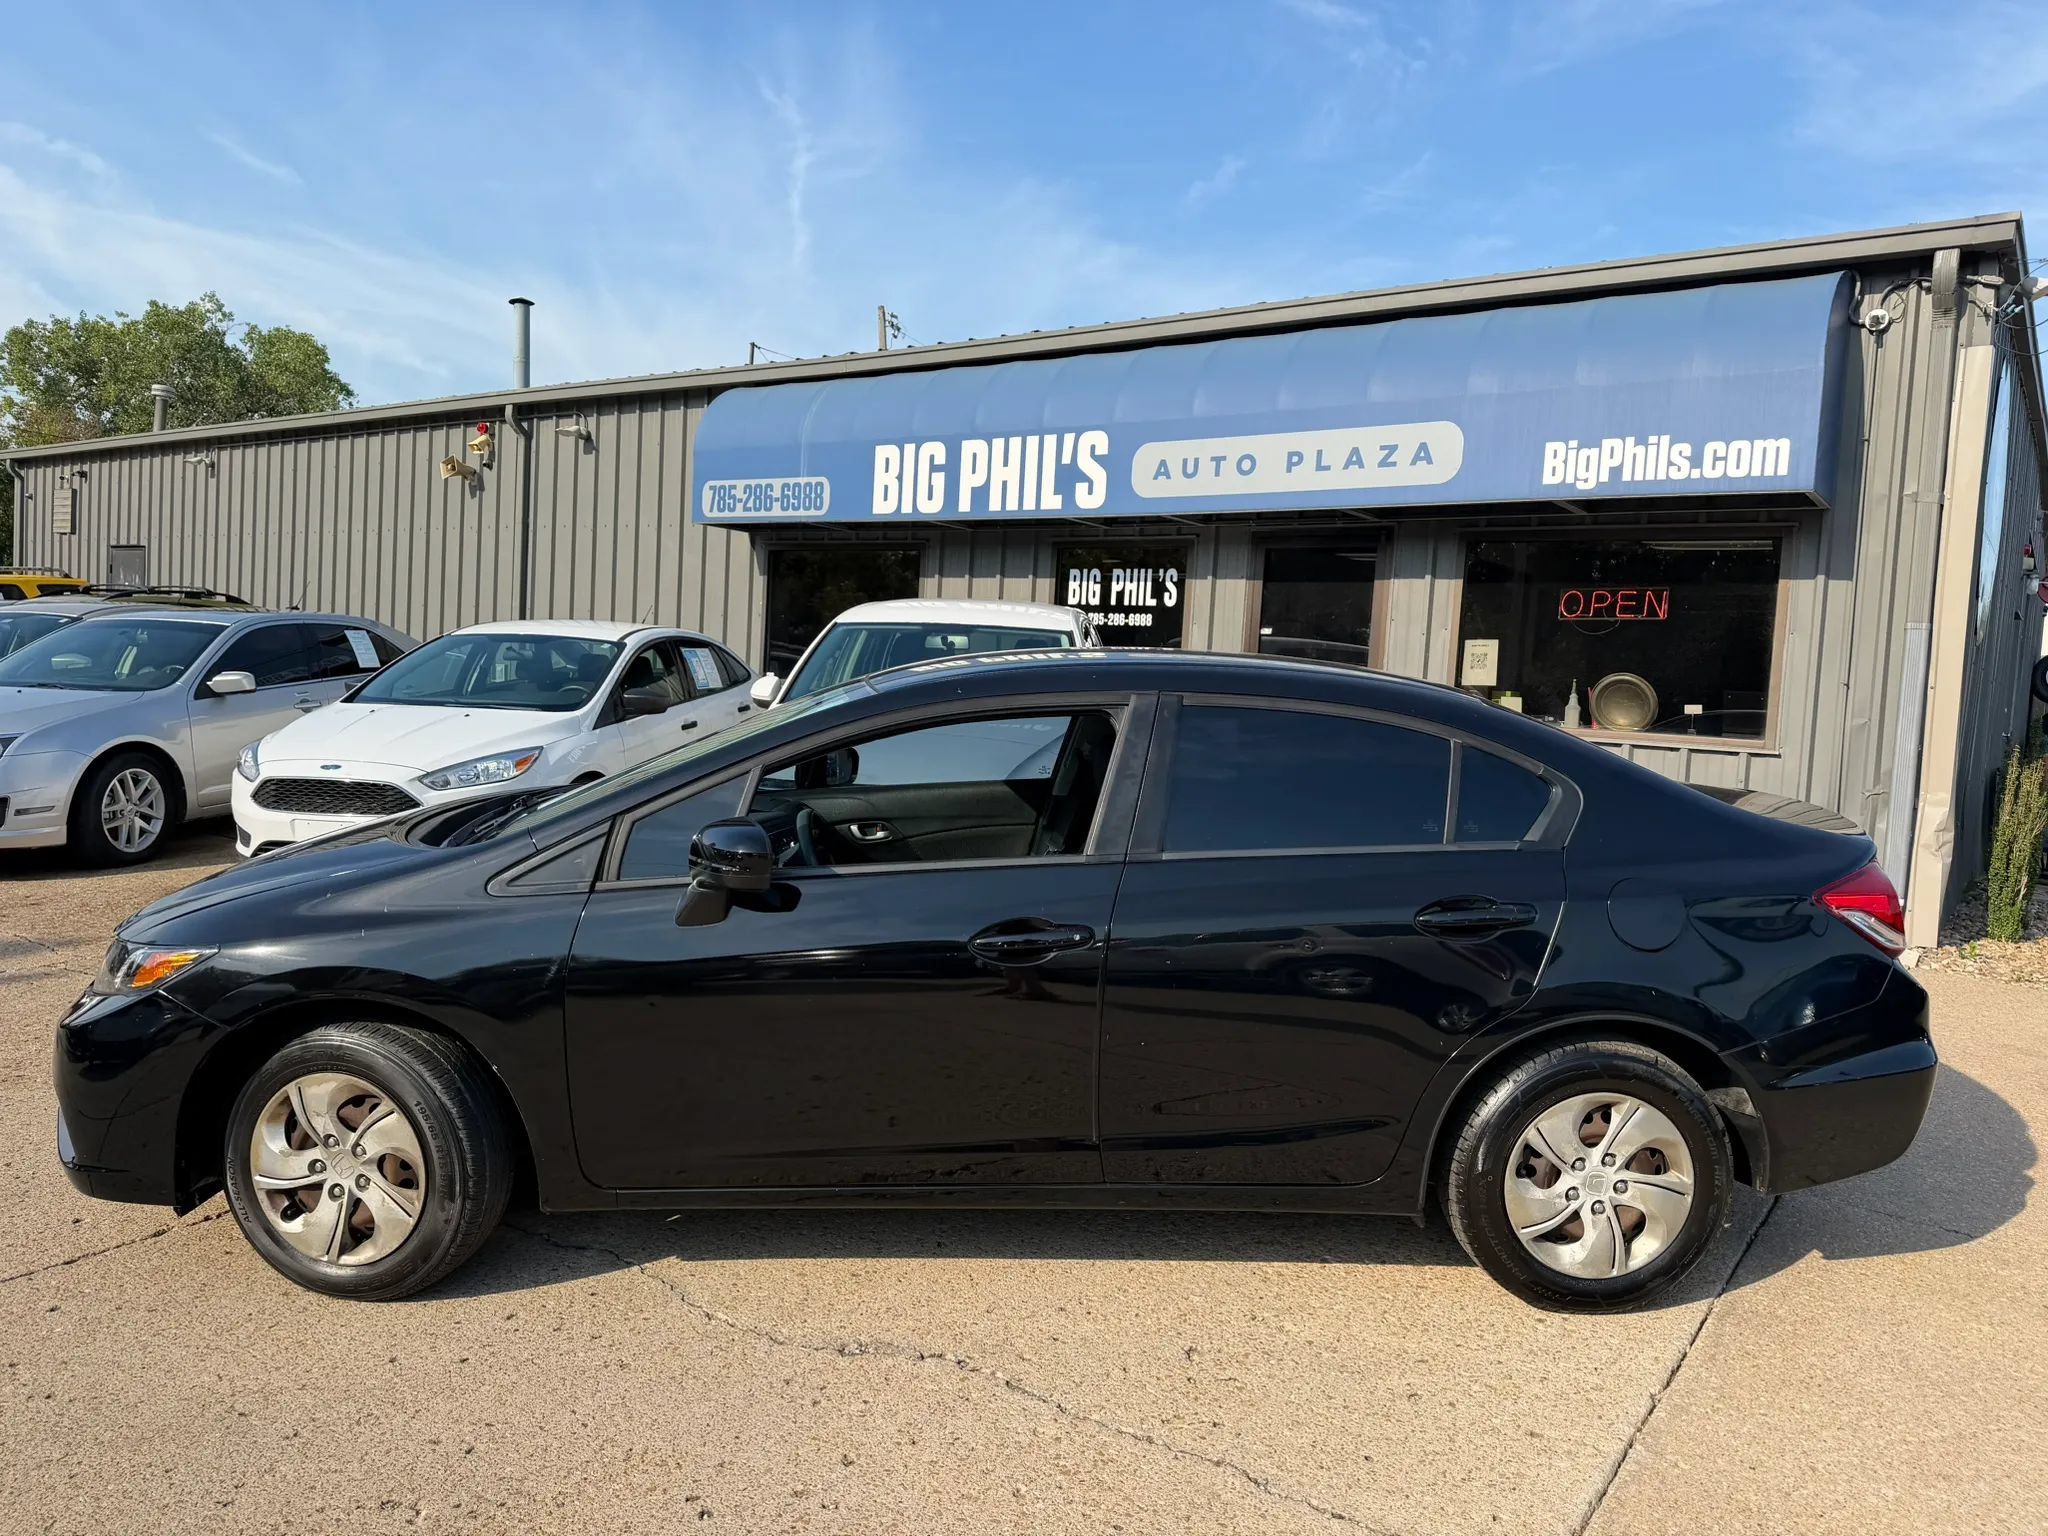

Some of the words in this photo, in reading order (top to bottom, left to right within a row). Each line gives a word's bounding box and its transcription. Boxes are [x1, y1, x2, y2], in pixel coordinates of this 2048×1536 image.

[872, 441, 946, 515] BIG
[958, 430, 1109, 513] PHIL'S
[1152, 453, 1257, 481] AUTO
[1285, 441, 1434, 474] PLAZA
[1542, 434, 1791, 490] BigPhils.com
[708, 481, 824, 513] 785-286-6988
[1067, 568, 1101, 606] BIG
[1110, 567, 1178, 607] PHIL'S
[1560, 590, 1668, 619] OPEN
[1087, 612, 1153, 627] 785-286-6988
[413, 1098, 438, 1141] 195/65
[226, 1155, 252, 1223] ALL-SEASON
